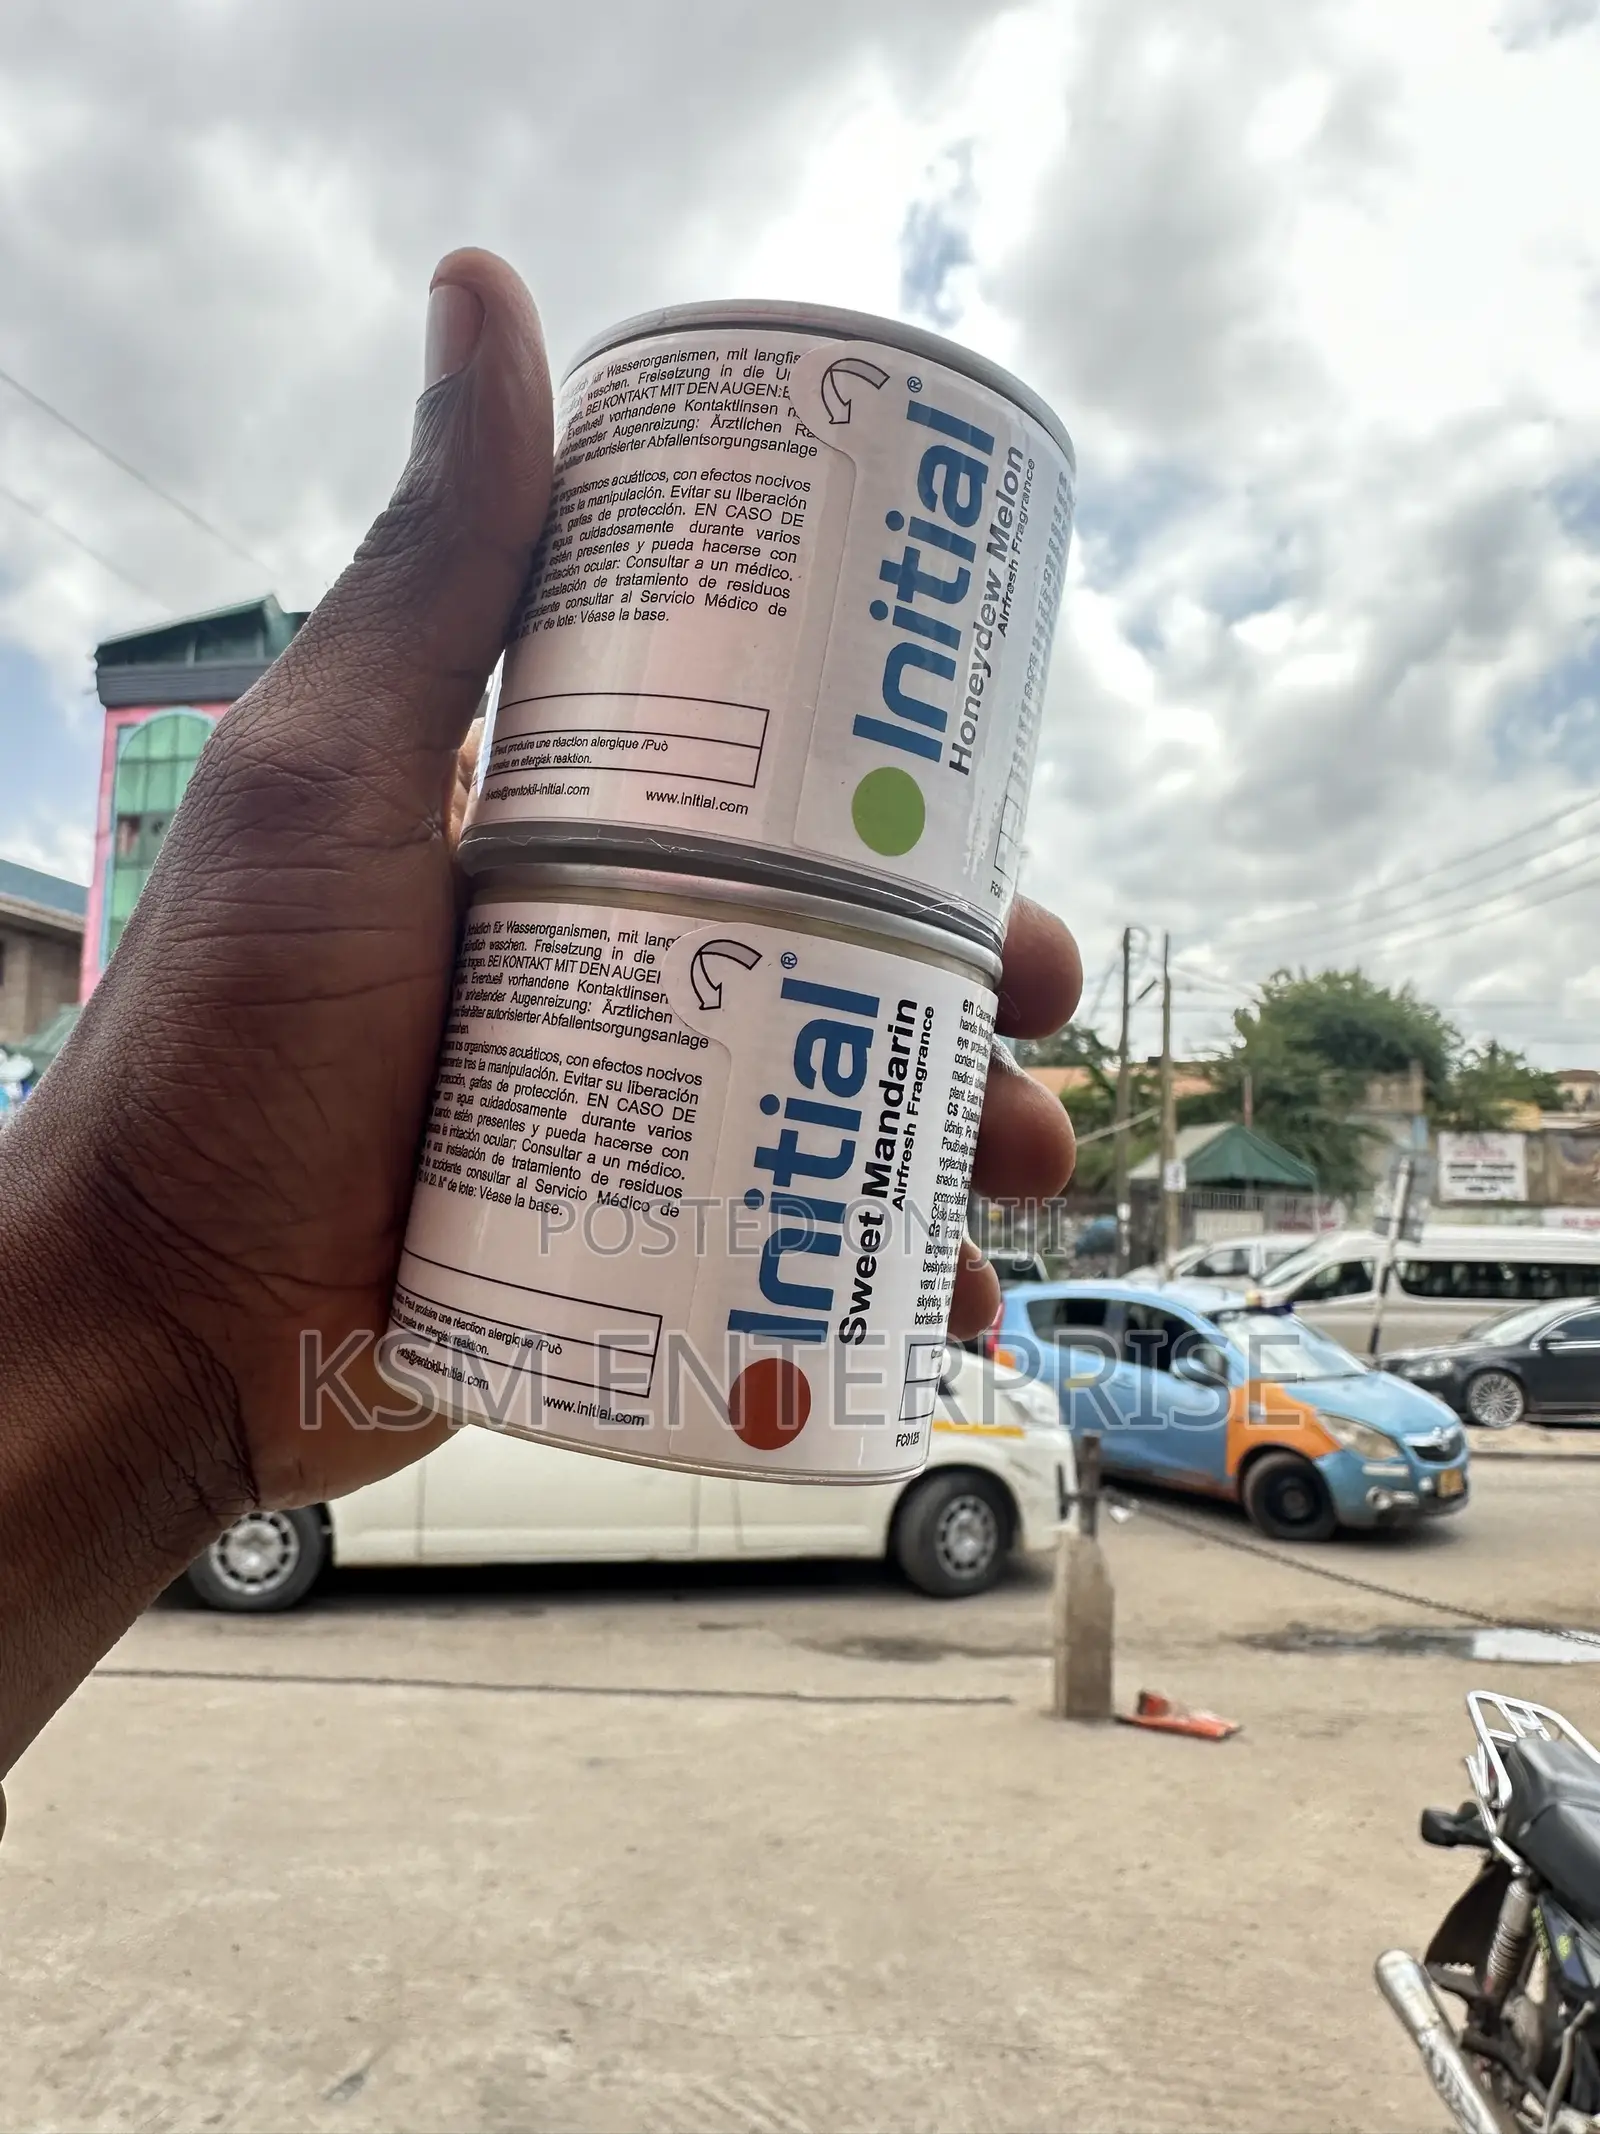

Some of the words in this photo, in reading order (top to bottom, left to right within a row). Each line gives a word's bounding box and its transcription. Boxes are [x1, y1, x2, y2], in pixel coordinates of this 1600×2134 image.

[727, 348, 748, 361] mit
[638, 366, 710, 384] Freisetzung
[720, 365, 732, 377] in
[743, 366, 764, 378] die
[602, 386, 658, 409] KONTAKT
[660, 383, 685, 397] MIT
[686, 382, 719, 394] DEN
[609, 402, 676, 422] vorhandene
[684, 399, 778, 415] Kontaktlinsen
[612, 418, 700, 437] Augenreizung:
[710, 414, 782, 433] Ärztlichen
[647, 433, 818, 458] Abfallentsorgungsanlage
[611, 470, 669, 487] acuáticos,
[673, 470, 697, 480] con
[700, 468, 752, 484] efectos
[755, 475, 811, 492] nocivos
[587, 486, 665, 508] manipulación.
[670, 485, 711, 499] Evitar
[714, 489, 731, 500] su
[736, 487, 807, 510] liberación
[597, 508, 612, 521] de
[617, 502, 686, 522] protección.
[694, 503, 717, 517] EN
[725, 504, 772, 522] CASO
[781, 511, 805, 528] DE
[579, 520, 674, 542] cuidadosamente
[689, 520, 744, 537] durante
[756, 528, 801, 545] varios
[576, 540, 630, 561] presentes
[635, 541, 645, 554] y
[651, 538, 694, 553] pueda
[702, 538, 761, 557] hacerse
[770, 549, 797, 563] con
[997, 557, 1020, 638] Airfresh
[1011, 458, 1036, 555] Fragrance
[583, 558, 620, 573] ocular:
[626, 555, 690, 569] Consultar
[694, 559, 704, 570] a
[710, 560, 728, 572] un
[735, 562, 793, 582] médico.
[593, 575, 608, 588] de
[616, 573, 689, 586] tratamiento
[699, 575, 717, 588] de
[727, 580, 791, 599] residuos
[565, 592, 614, 610] consultar
[620, 590, 632, 603] al
[640, 590, 695, 605] Servicio
[704, 593, 759, 612] Médico
[768, 602, 787, 617] de
[580, 609, 615, 623] Véase
[619, 608, 630, 621] la
[634, 607, 669, 621] base.
[949, 569, 1002, 776] Honeydew
[987, 446, 1024, 563] Melon
[646, 790, 749, 815] www.initial.com
[506, 920, 610, 942] Wasserorganismen,
[618, 930, 638, 944] mit
[534, 939, 602, 960] Freisetzung
[611, 946, 624, 960] in
[634, 949, 655, 964] die
[502, 955, 553, 971] KONTAKT
[554, 958, 578, 973] MIT
[579, 961, 611, 977] DEN
[508, 973, 569, 991] vorhandene
[510, 991, 591, 1014] Augenreizung:
[602, 998, 673, 1024] Ärztlichen
[541, 1012, 709, 1050] Abfallentsorgungsanlage
[509, 1047, 562, 1066] acuáticos,
[566, 1055, 589, 1067] con
[592, 1057, 643, 1076] efectos
[646, 1066, 702, 1086] nocivos
[488, 1062, 558, 1082] manipulación.
[563, 1070, 603, 1089] Evitar
[605, 1080, 622, 1093] su
[627, 1080, 699, 1105] liberación
[497, 1079, 509, 1092] de
[514, 1084, 579, 1104] protección.
[587, 1092, 609, 1108] EN
[617, 1098, 664, 1117] CASO
[672, 1107, 697, 1123] DE
[861, 998, 918, 1198] Mandarin
[892, 1123, 917, 1212] Airfresh
[907, 1006, 935, 1116] Fragrance
[480, 1095, 567, 1120] cuidadosamente
[581, 1111, 636, 1132] durante
[647, 1125, 693, 1142] varios
[477, 1114, 526, 1132] presentes
[531, 1124, 540, 1137] y
[545, 1126, 586, 1143] pueda
[594, 1132, 653, 1154] hacerse
[662, 1147, 689, 1161] con
[522, 1138, 582, 1161] Consultar
[587, 1153, 596, 1164] a
[603, 1155, 620, 1169] un
[627, 1160, 685, 1180] médico.
[492, 1152, 505, 1166] de
[512, 1155, 581, 1180] tratamiento
[591, 1171, 609, 1185] de
[619, 1178, 683, 1199] residuos
[459, 1180, 477, 1197] lote:
[480, 1185, 512, 1205] Véase
[515, 1193, 525, 1208] la
[528, 1199, 562, 1216] base.
[466, 1167, 511, 1186] consultar
[516, 1176, 528, 1189] al
[535, 1178, 588, 1200] Servicio
[597, 1190, 650, 1212] Médico
[660, 1203, 680, 1217] de
[839, 1210, 885, 1345] Sweet
[543, 1395, 645, 1426] www.initial.com
